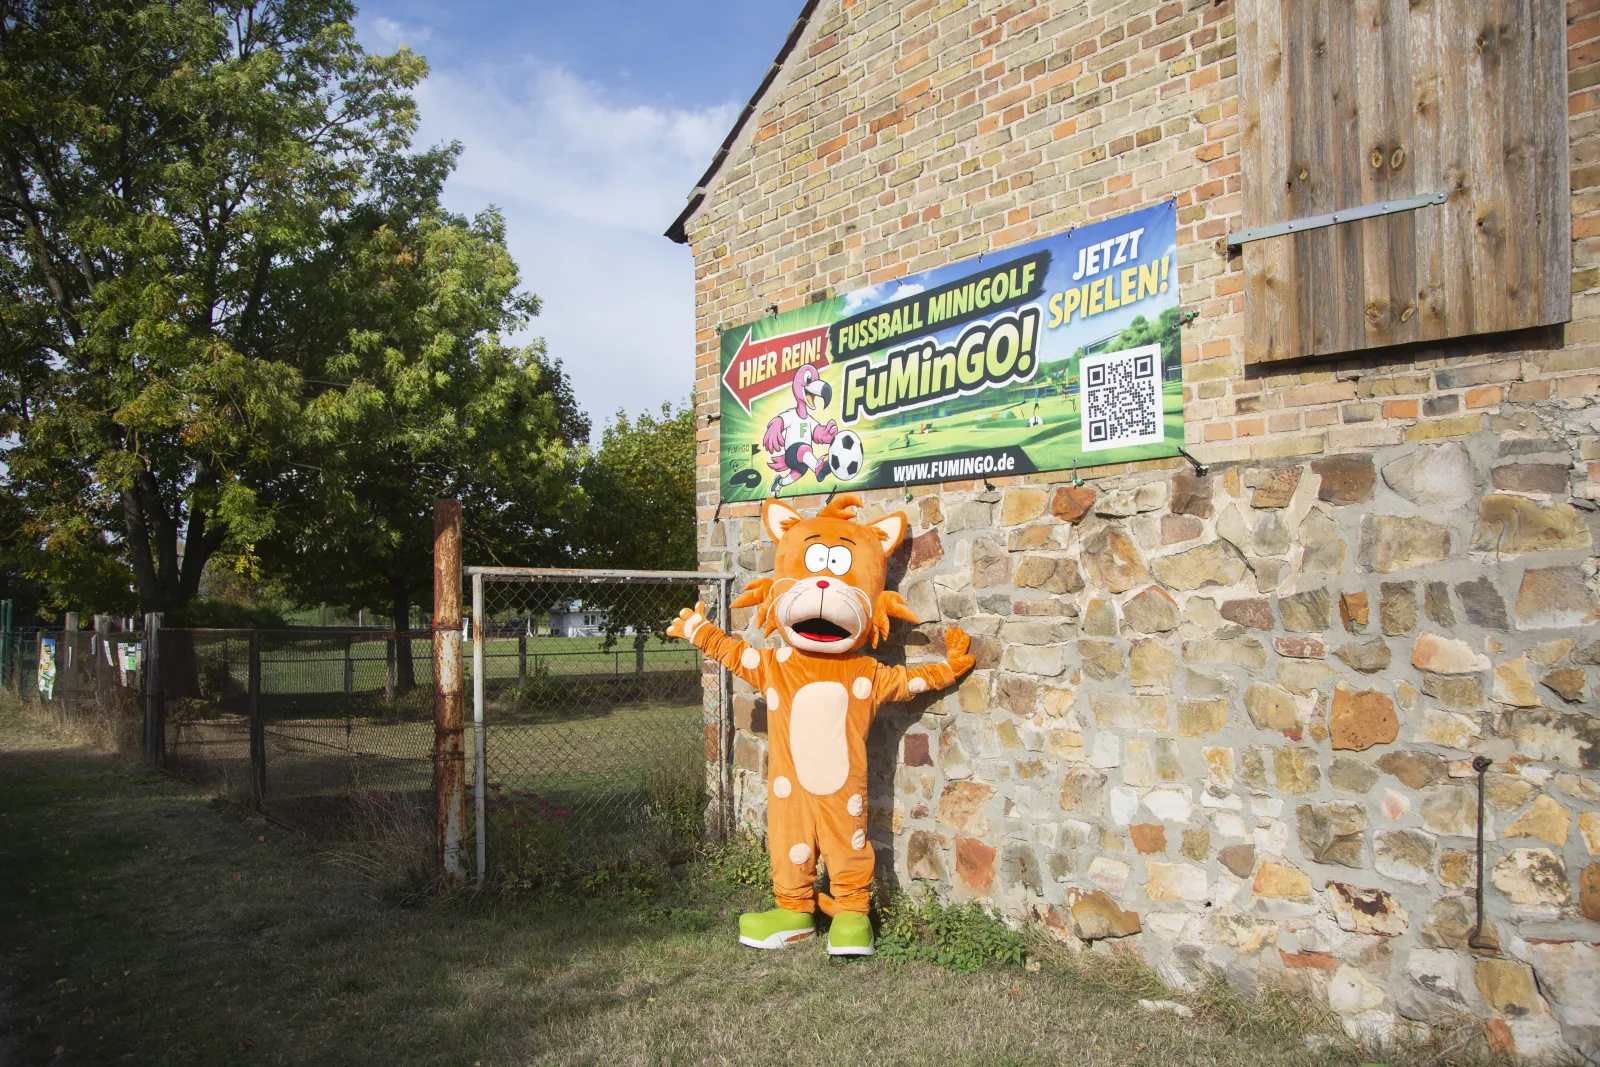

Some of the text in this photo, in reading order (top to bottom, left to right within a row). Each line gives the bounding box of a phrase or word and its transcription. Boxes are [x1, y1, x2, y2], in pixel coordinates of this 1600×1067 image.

[1072, 227, 1145, 281] JETZT
[838, 262, 1036, 354] FUSSBALL MINIGOLF
[1047, 255, 1170, 329] SPIELEN!
[738, 336, 822, 390] HIER REIN!
[843, 311, 1038, 419] FuMinGO!
[799, 423, 808, 438] F
[893, 453, 1015, 482] WWW.FUMINGO.de
